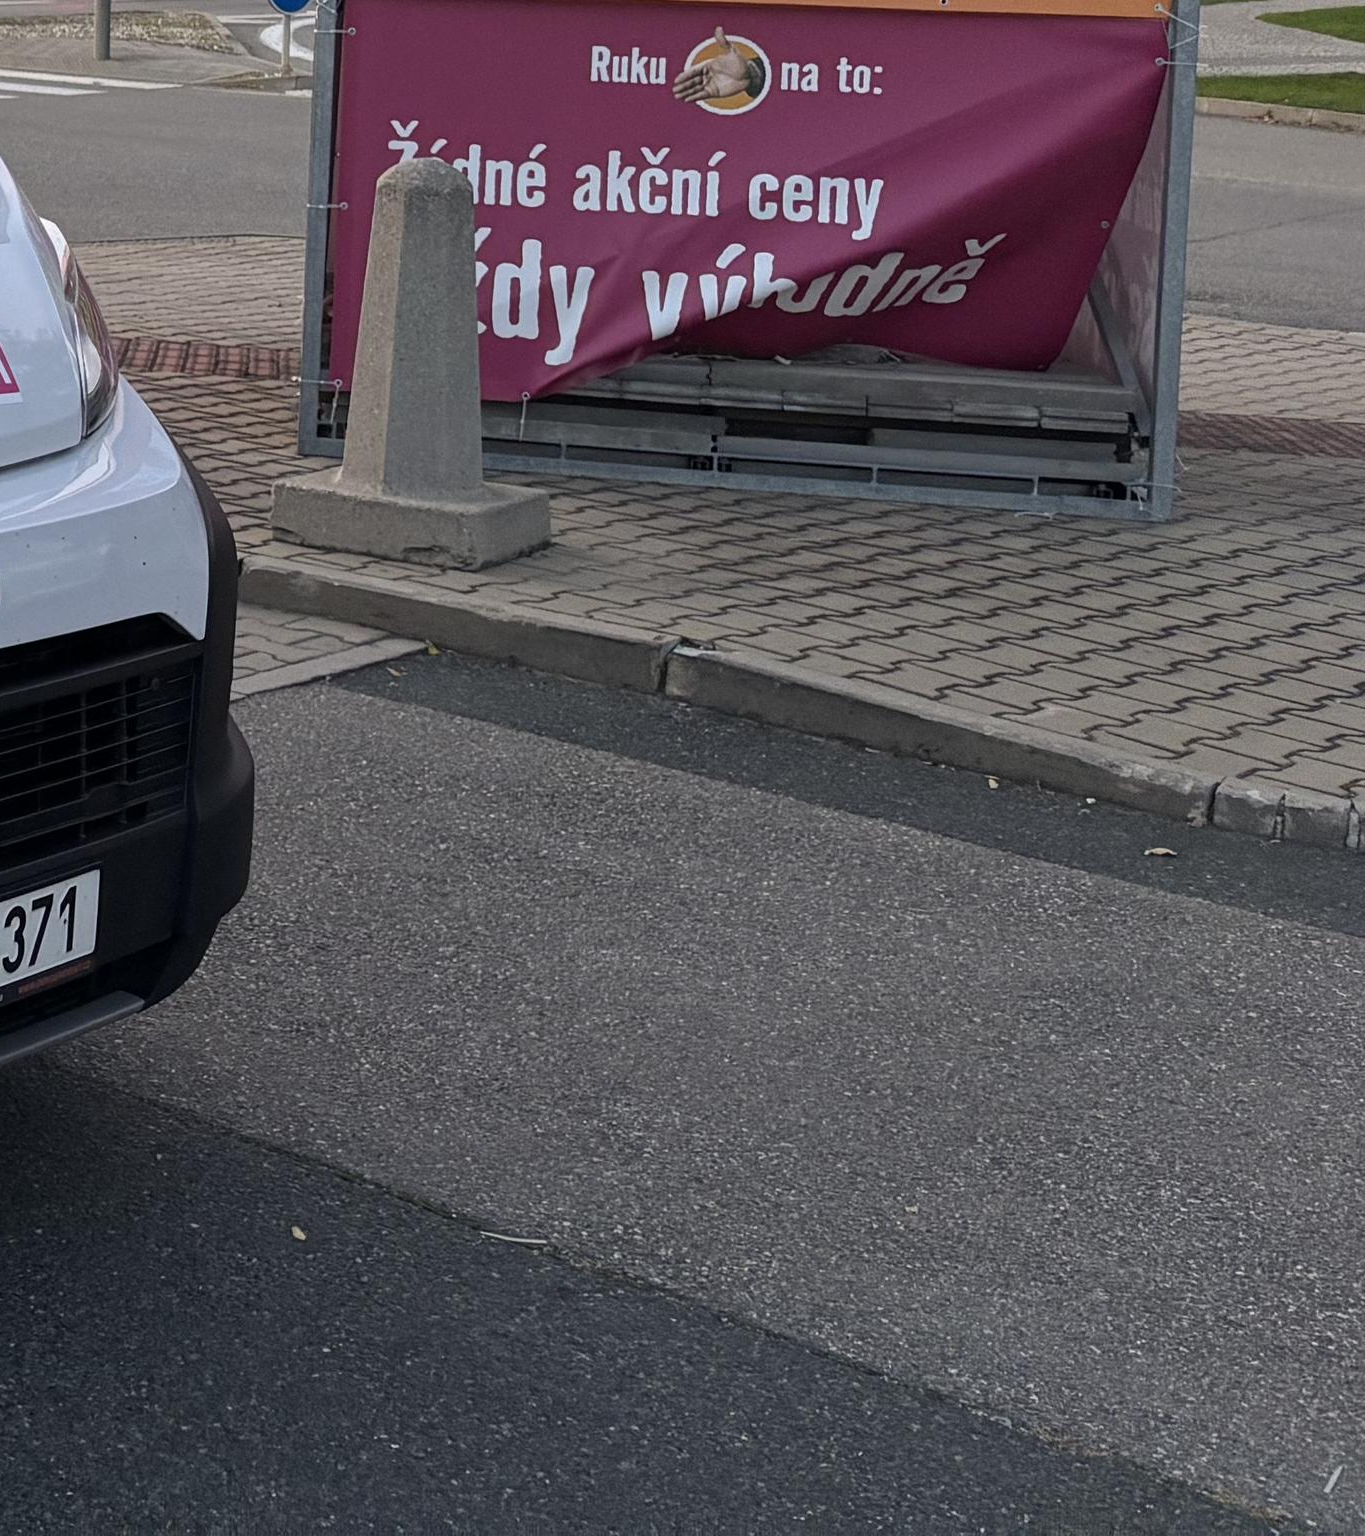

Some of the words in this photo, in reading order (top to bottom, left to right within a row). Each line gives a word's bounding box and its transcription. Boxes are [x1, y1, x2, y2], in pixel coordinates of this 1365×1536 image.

[591, 45, 667, 86] Ruku
[780, 58, 818, 92] na
[837, 57, 884, 95] to:
[573, 146, 721, 218] akční
[748, 173, 884, 241] ceny
